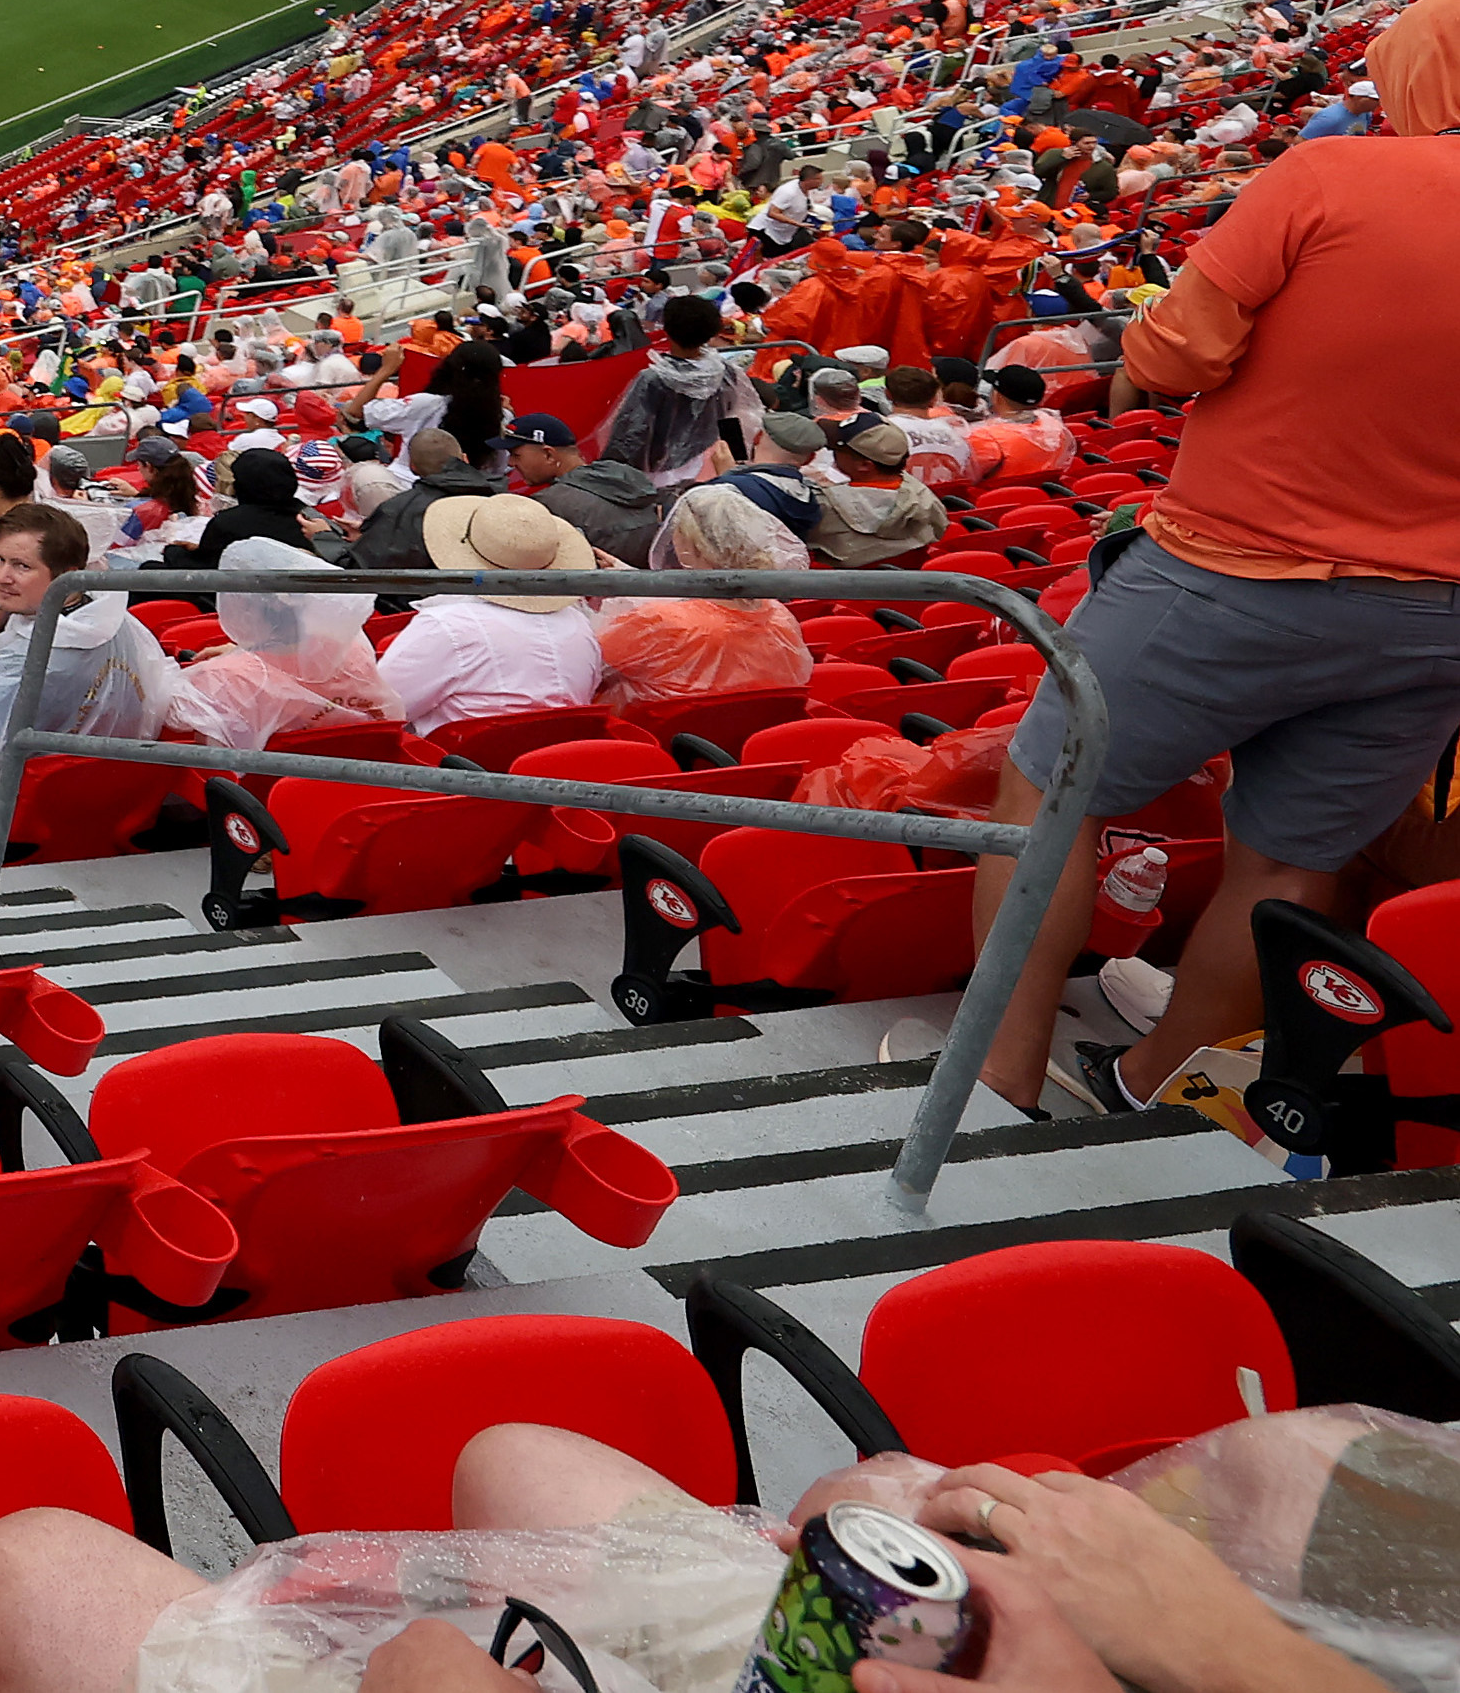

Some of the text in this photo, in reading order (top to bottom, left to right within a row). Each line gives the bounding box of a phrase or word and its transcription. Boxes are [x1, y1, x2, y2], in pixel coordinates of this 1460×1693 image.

[211, 904, 228, 926] 38
[625, 989, 649, 1016] 39
[1266, 1101, 1304, 1134] 40
